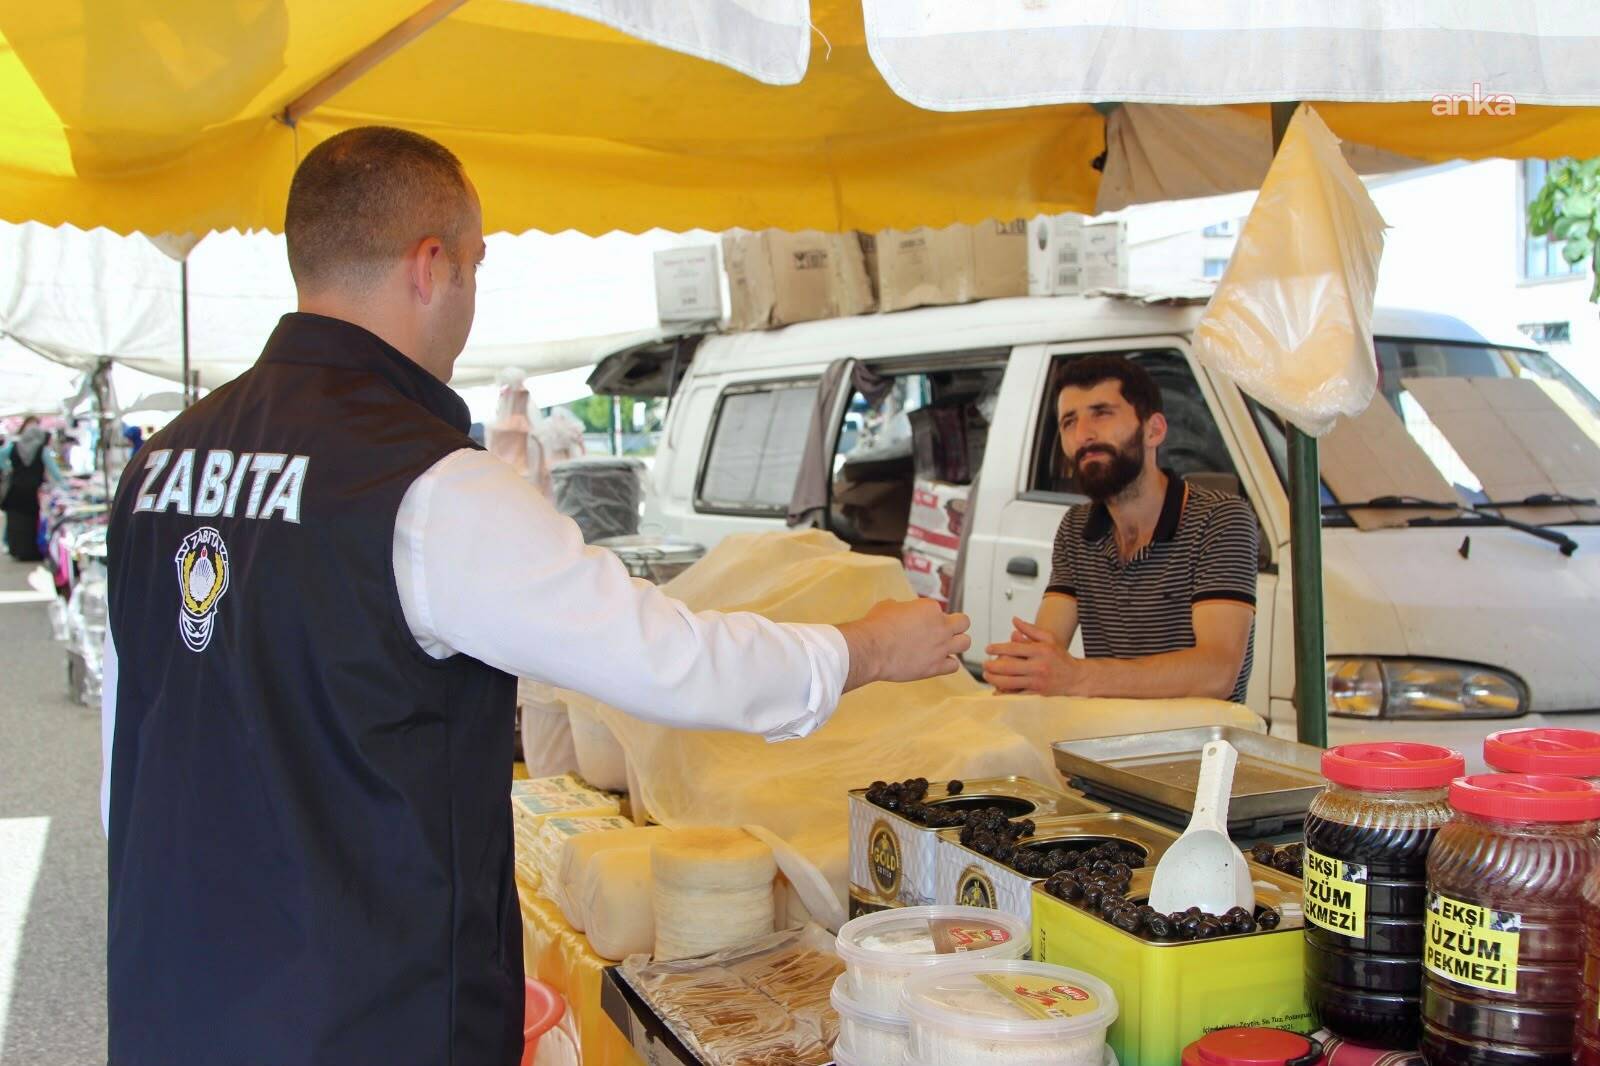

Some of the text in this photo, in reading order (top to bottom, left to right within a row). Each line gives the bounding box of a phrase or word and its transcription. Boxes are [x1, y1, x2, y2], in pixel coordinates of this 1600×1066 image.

[132, 448, 310, 525] ZABITA
[190, 530, 220, 551] ZABITA
[873, 847, 897, 872] GOLD
[1308, 853, 1338, 879] EKŞİ
[1305, 898, 1357, 932] EKMEZİ
[1442, 901, 1485, 929] EKŞİ
[1431, 920, 1502, 962] ÜZÜM
[1427, 946, 1507, 986] PEKMEZİ
